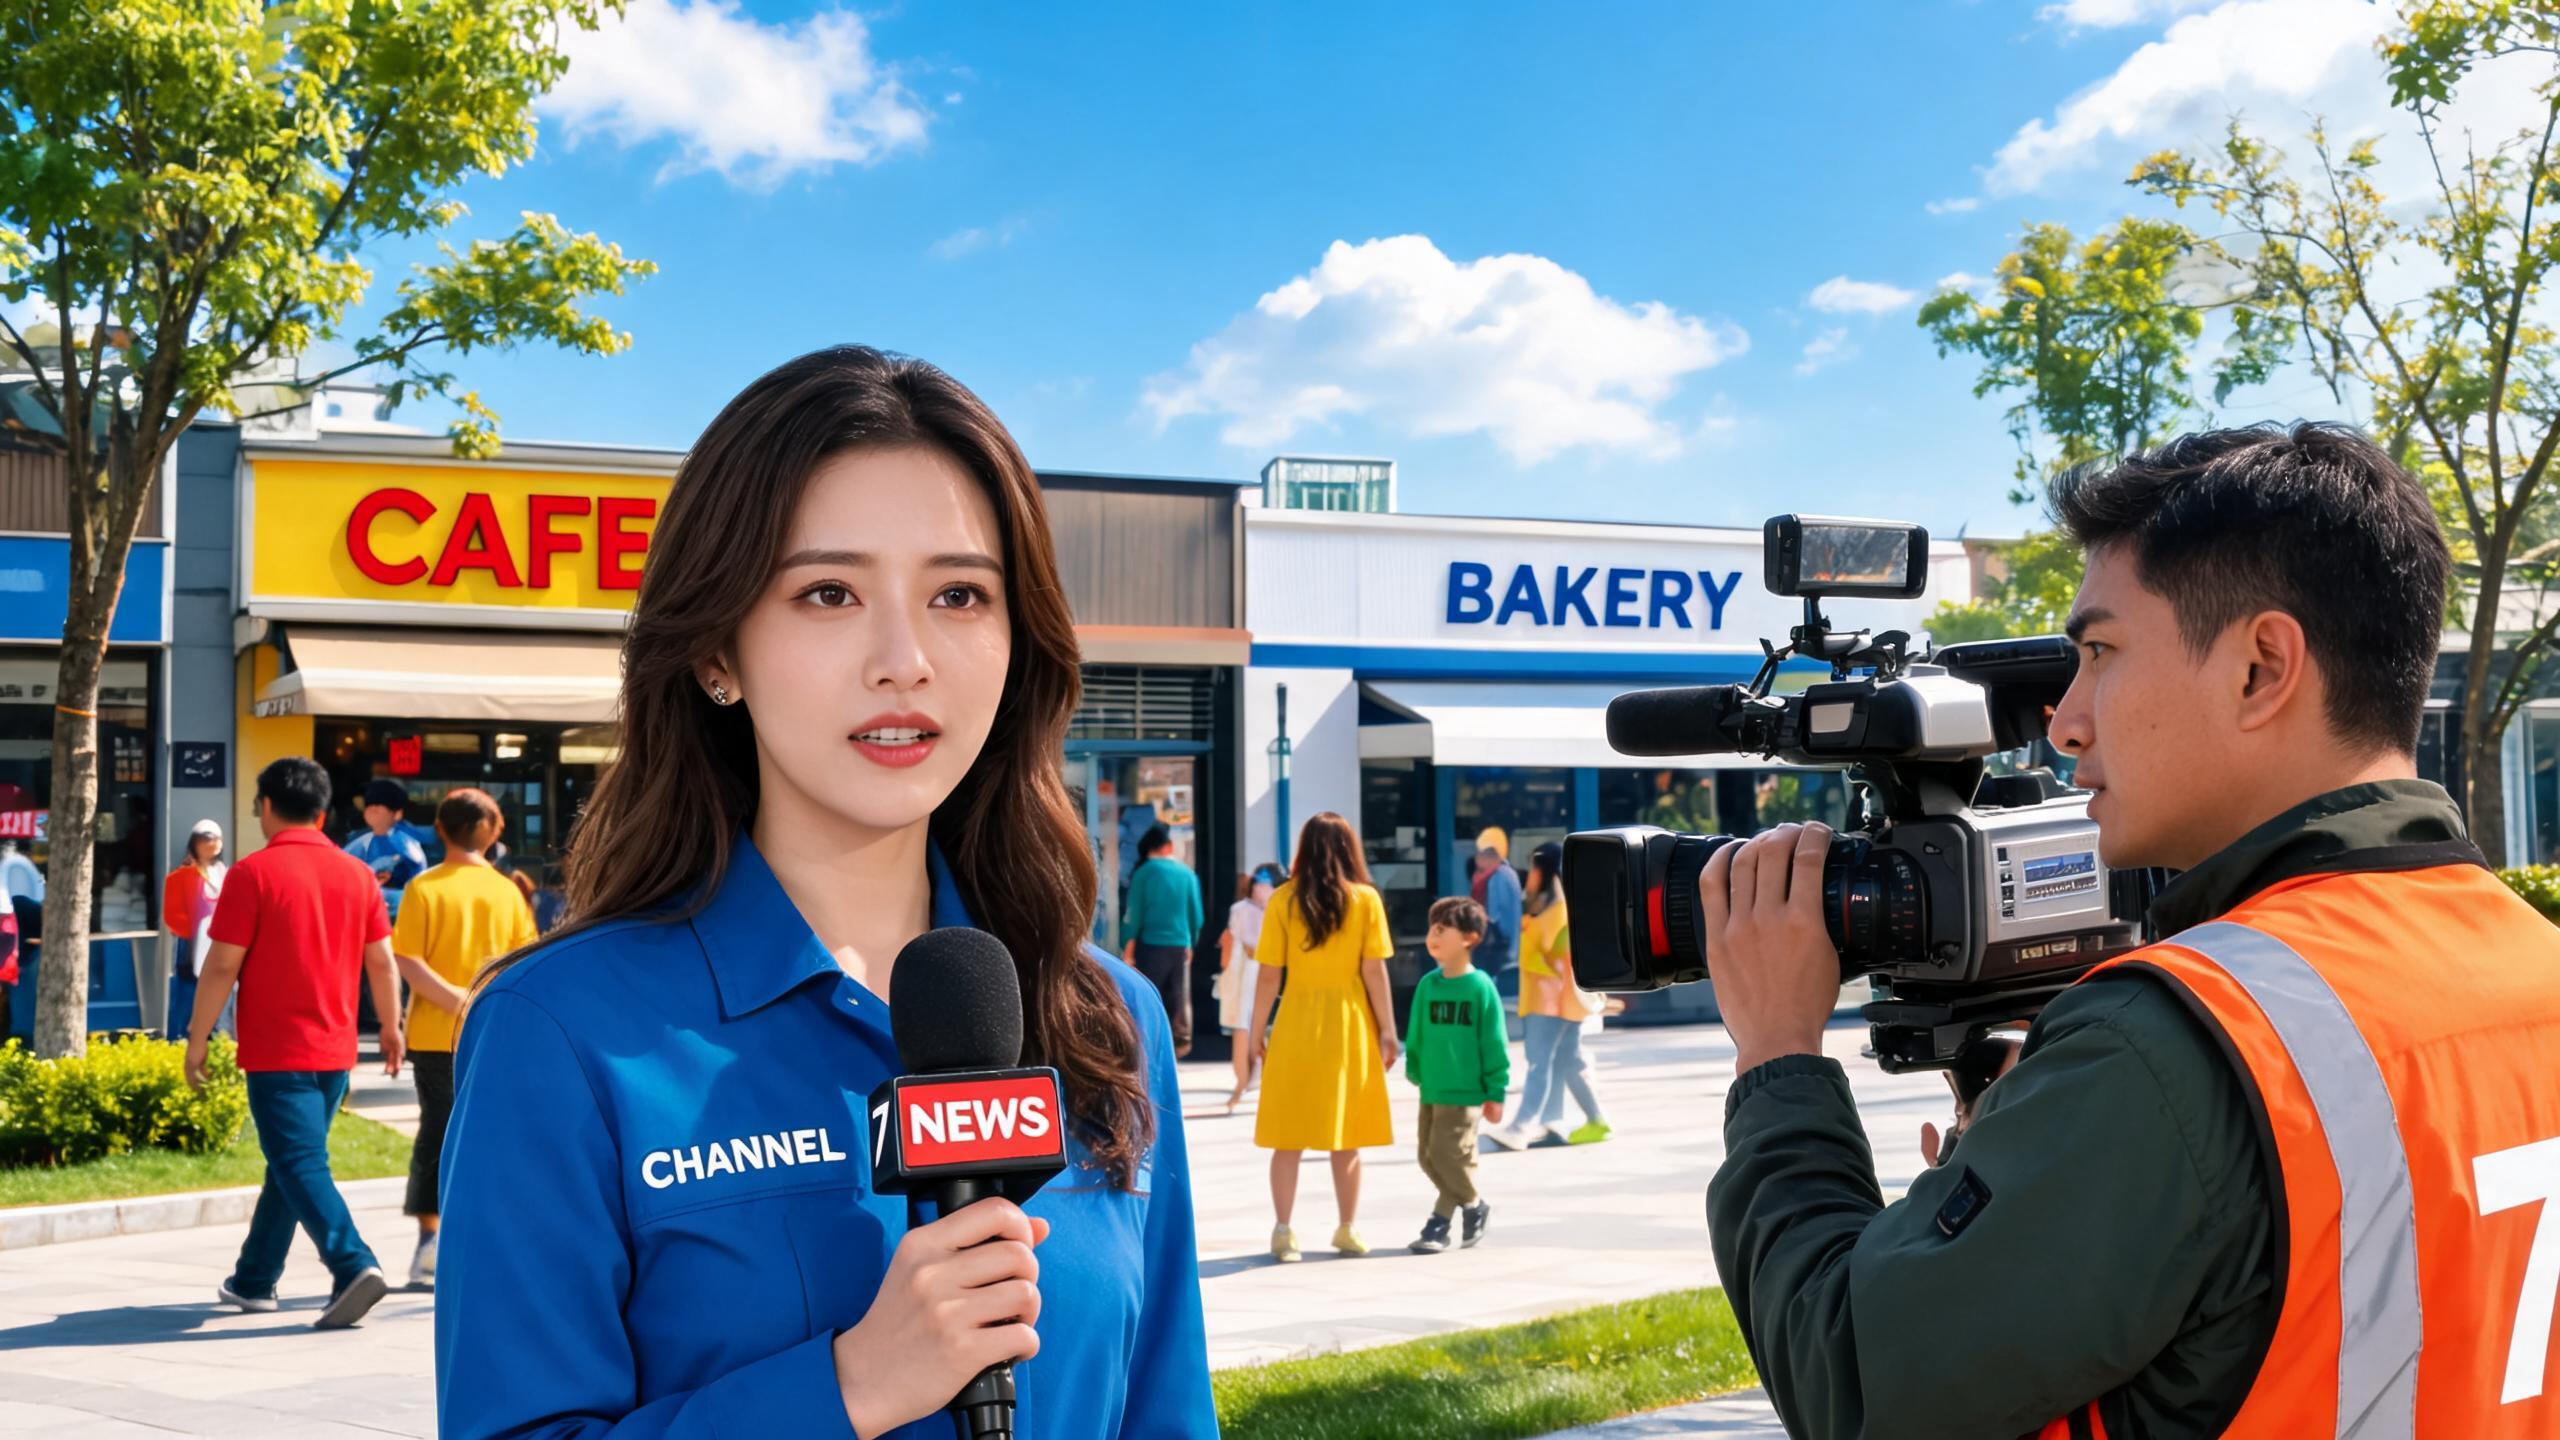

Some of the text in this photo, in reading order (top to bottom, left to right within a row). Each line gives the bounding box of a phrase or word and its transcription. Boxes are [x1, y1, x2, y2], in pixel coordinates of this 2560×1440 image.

[345, 487, 657, 591] CAFE
[1446, 561, 1742, 630] BAKERY
[872, 1100, 890, 1168] 7
[910, 1096, 1050, 1145] NEWS
[642, 1128, 847, 1189] CHANNEL
[2471, 1135, 2560, 1405] 7
